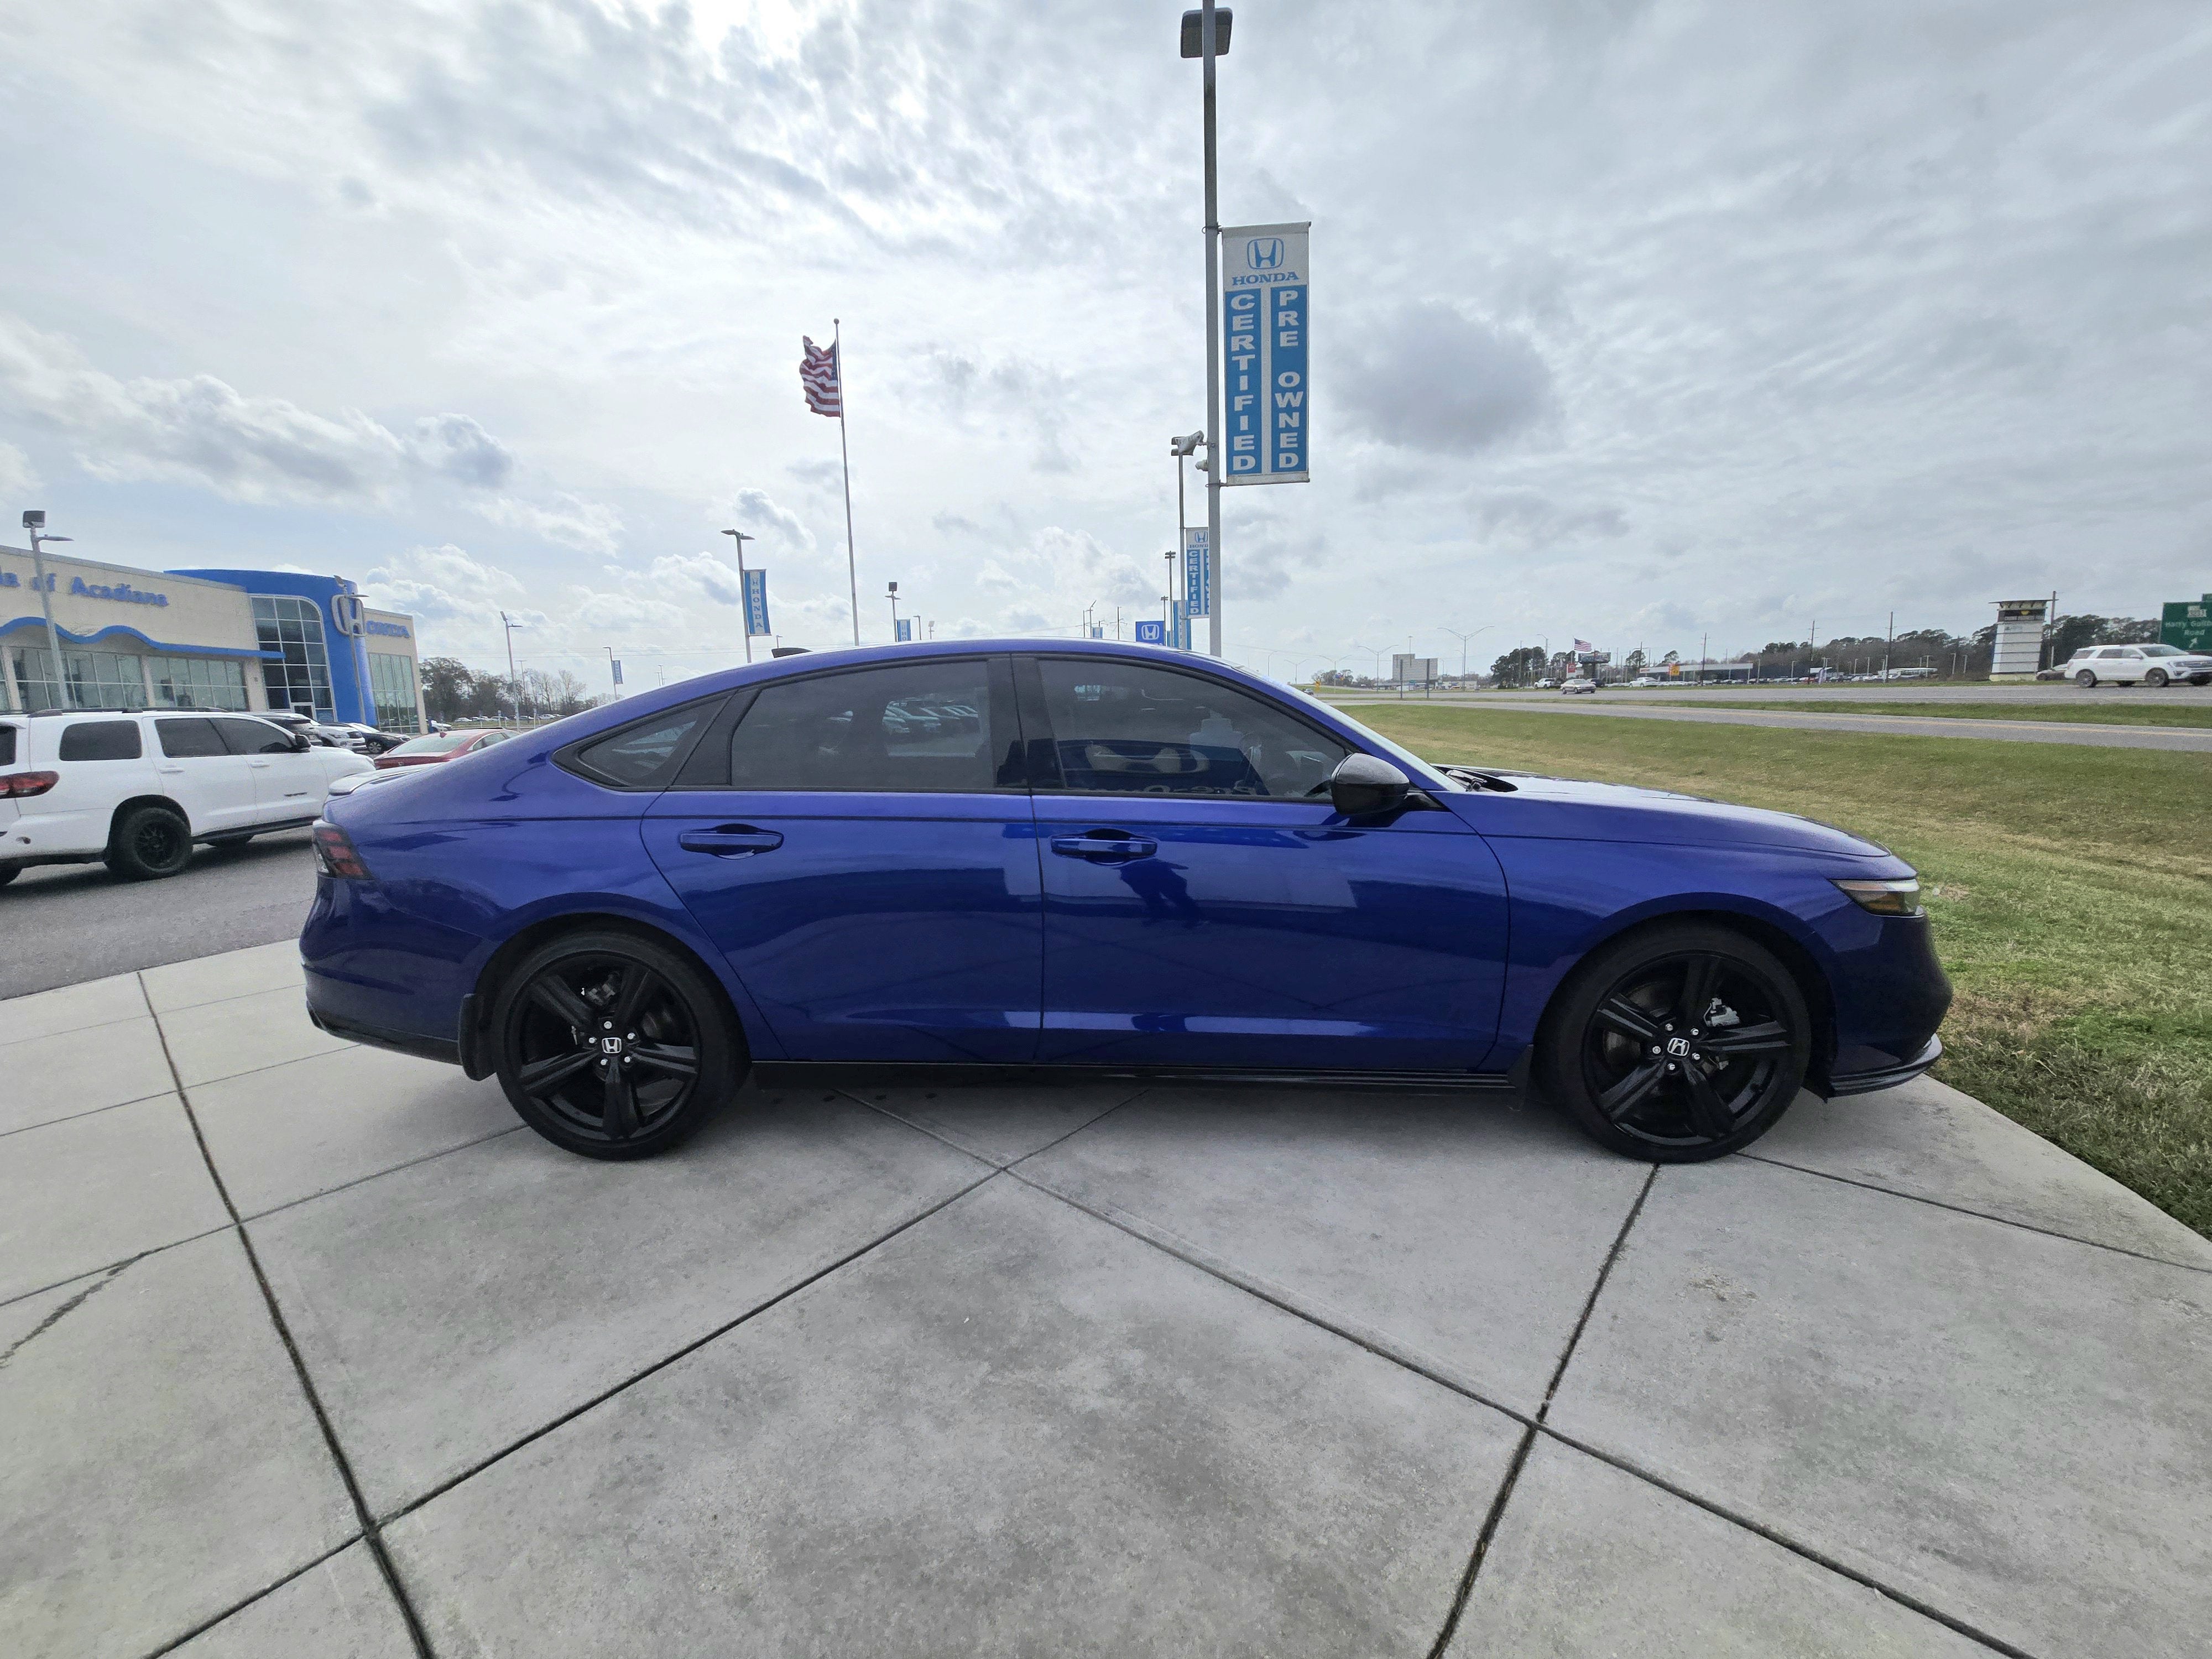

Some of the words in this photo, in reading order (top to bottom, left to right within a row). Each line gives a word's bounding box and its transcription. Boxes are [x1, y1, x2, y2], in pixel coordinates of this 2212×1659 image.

[1232, 271, 1298, 286] HONDA
[1277, 290, 1299, 347] PRE
[1230, 293, 1256, 471] CERTIFIED
[1275, 371, 1303, 468] OWNED
[71, 576, 169, 607] Acadiana
[1190, 551, 1199, 614] CERTIFIED
[367, 620, 410, 638] ONDA
[752, 588, 763, 628] HONDA
